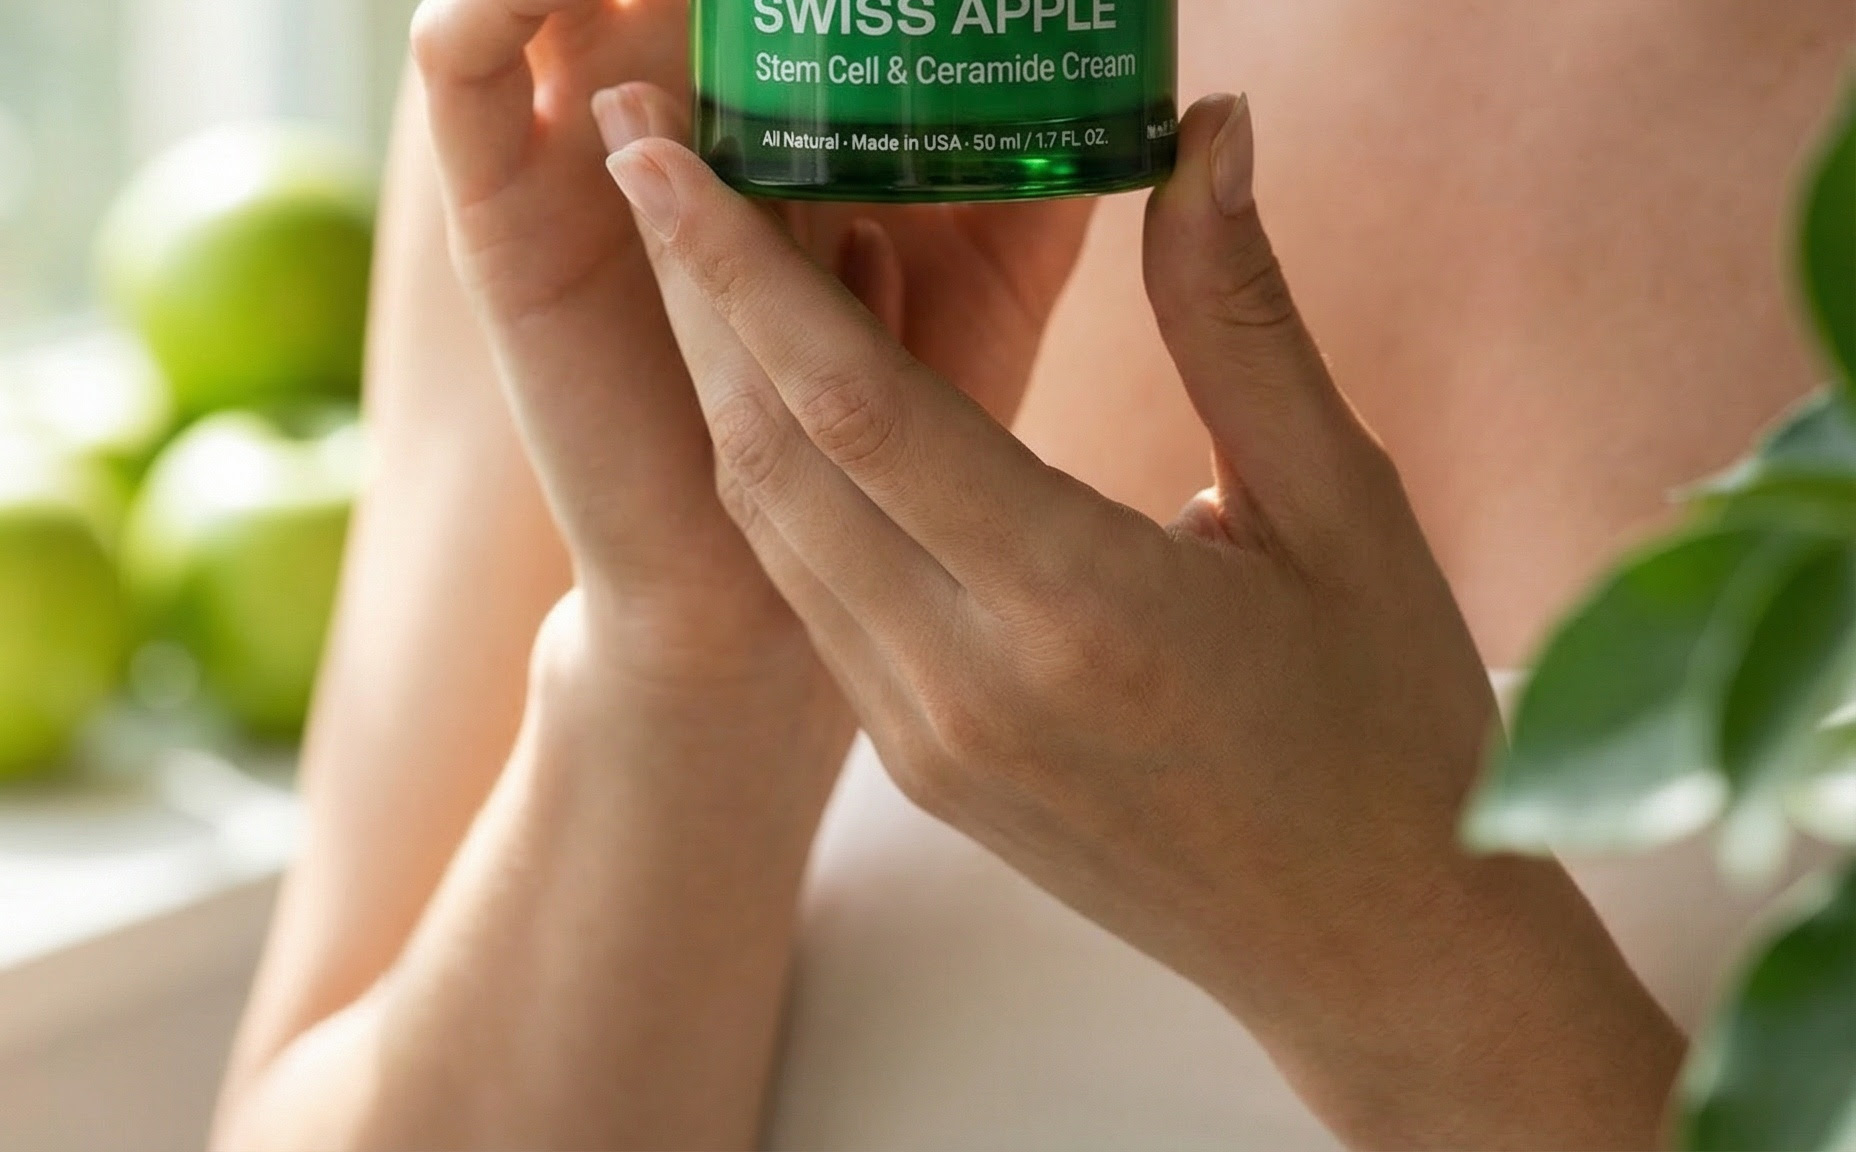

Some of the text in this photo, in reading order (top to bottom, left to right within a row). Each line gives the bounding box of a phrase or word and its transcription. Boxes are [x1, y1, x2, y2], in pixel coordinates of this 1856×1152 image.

[755, 52, 1136, 85] Stem Cell & Ceramide Cream
[762, 130, 782, 148] All
[783, 131, 840, 151] Natural
[852, 134, 900, 152] Made
[903, 134, 920, 152] in
[923, 134, 962, 152] USA
[973, 134, 996, 152] 50
[1000, 132, 1021, 151] ml
[1036, 131, 1057, 150] 1.7
[1062, 131, 1081, 148] FL
[1085, 128, 1109, 147] OZ.
